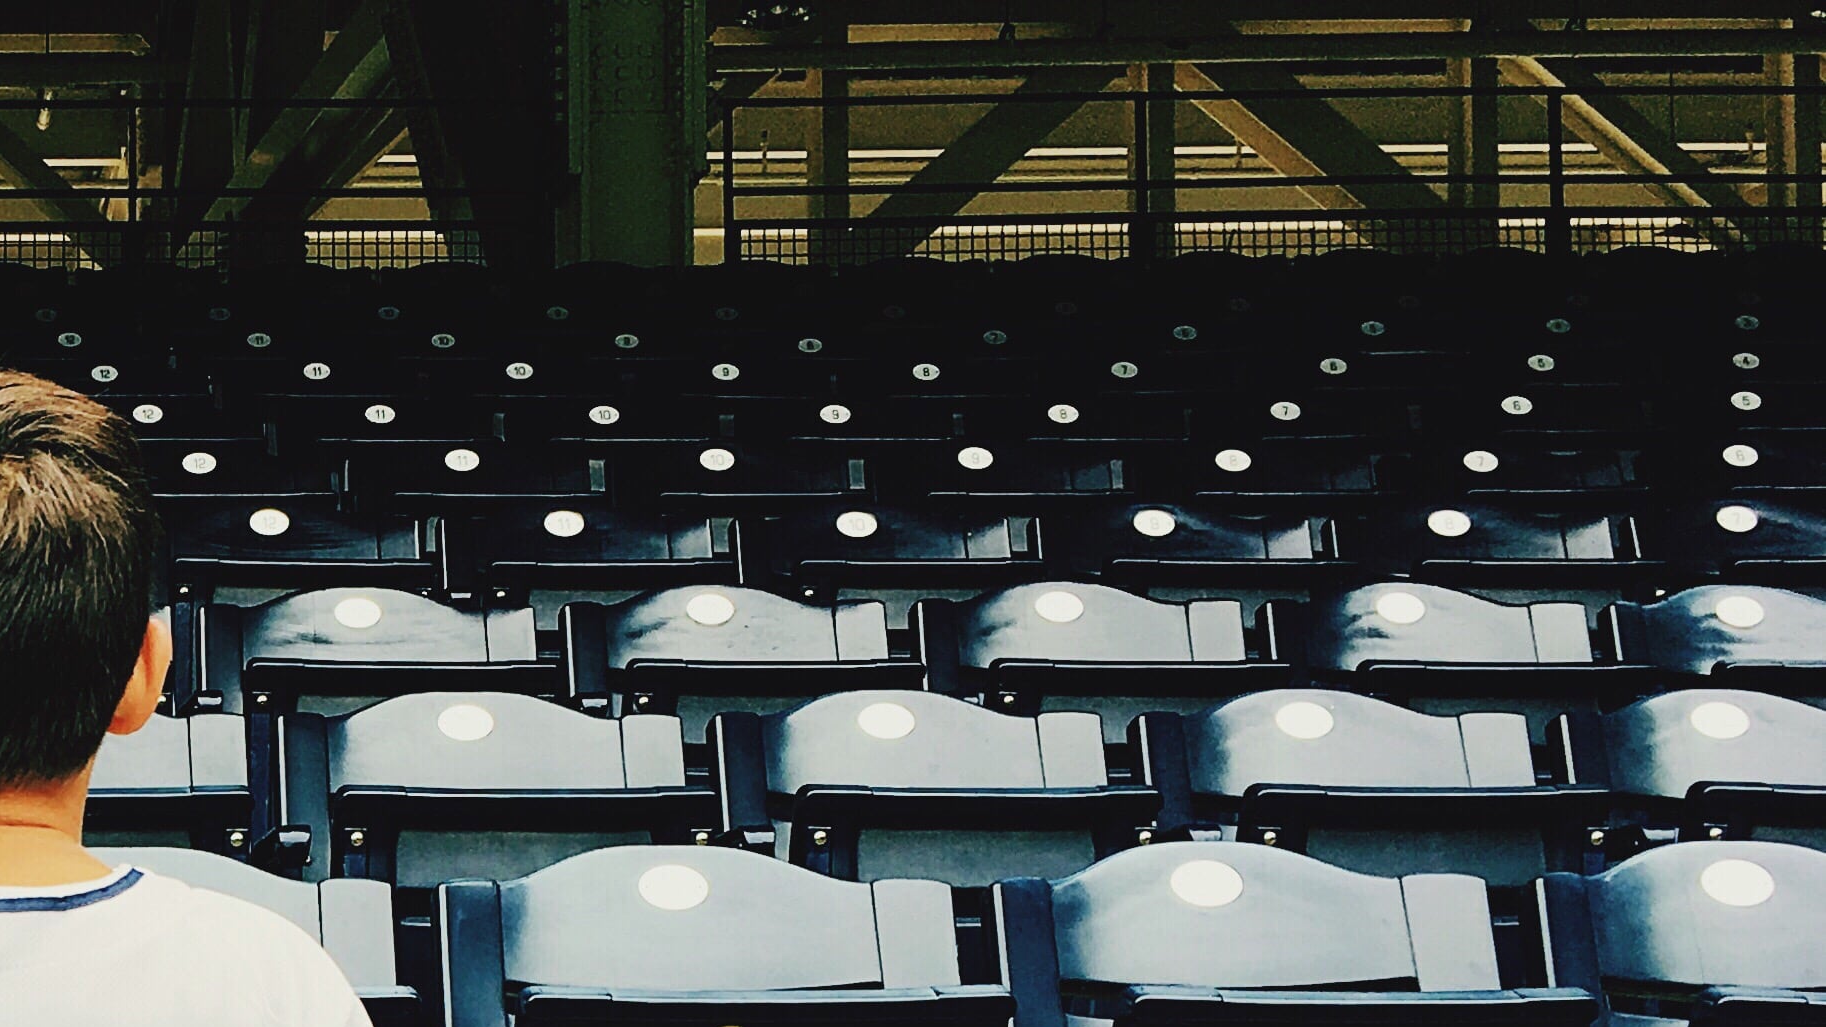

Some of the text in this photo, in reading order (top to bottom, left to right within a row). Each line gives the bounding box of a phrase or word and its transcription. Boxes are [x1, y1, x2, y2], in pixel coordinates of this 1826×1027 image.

[99, 369, 110, 379] 12
[313, 366, 322, 377] 11
[514, 366, 526, 376] 10
[142, 409, 154, 419] 12
[376, 409, 385, 419] 11
[599, 410, 611, 420] 10
[263, 516, 277, 530] 12
